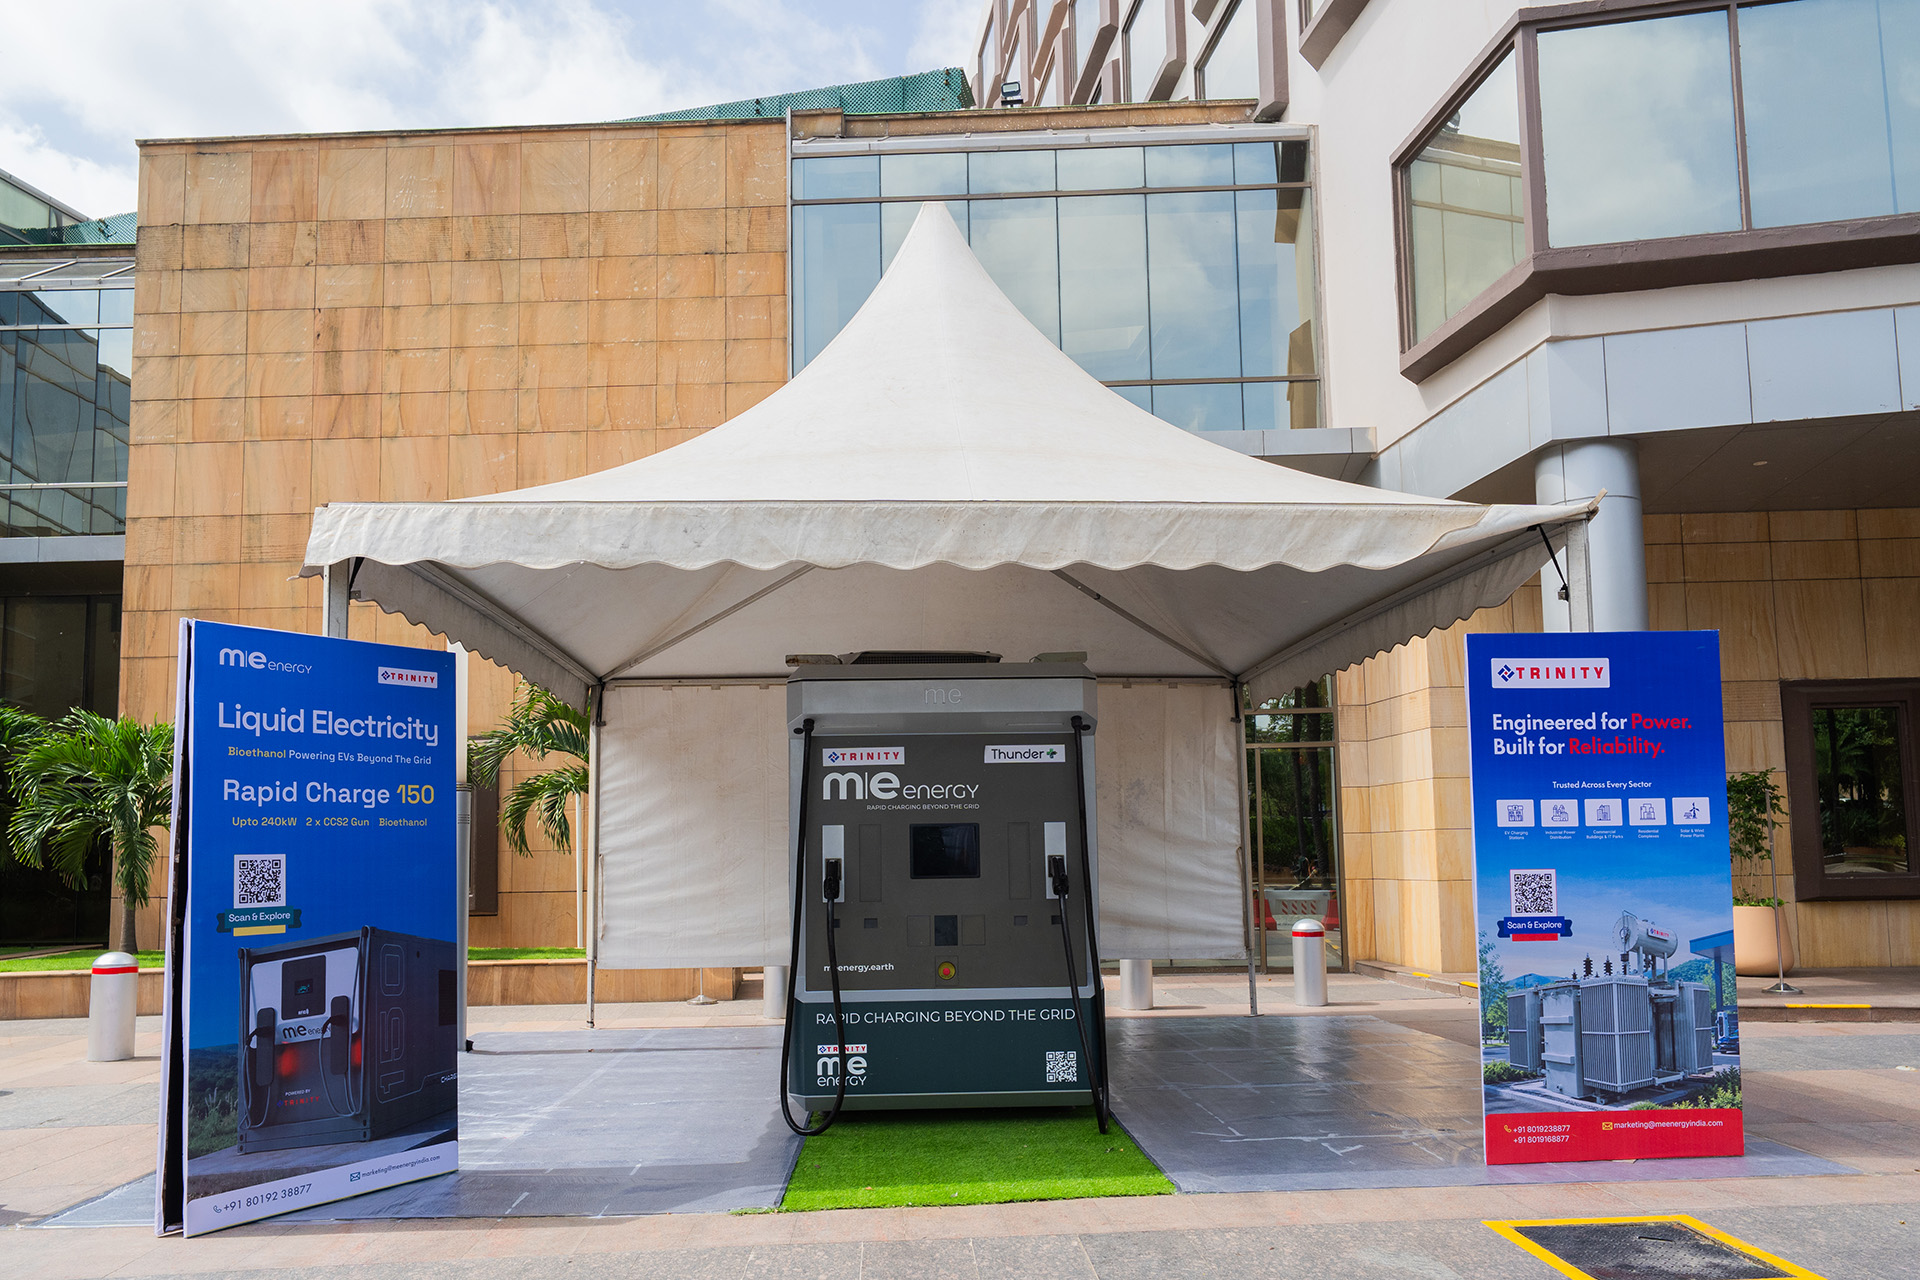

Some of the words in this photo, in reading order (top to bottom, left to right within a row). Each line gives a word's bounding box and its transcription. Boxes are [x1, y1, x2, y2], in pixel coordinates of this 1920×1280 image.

[390, 672, 436, 684] TRINITY
[1516, 666, 1604, 679] TRINITY
[924, 687, 962, 704] me
[218, 702, 304, 737] Liquid
[312, 710, 439, 746] Electricity
[1492, 712, 1597, 735] Engineered
[1600, 712, 1628, 730] for
[1631, 713, 1692, 730] Power.
[1494, 738, 1535, 755] Built
[1538, 737, 1566, 755] for
[1569, 736, 1665, 758] Reliability.
[228, 747, 286, 759] Bioethanol
[288, 750, 336, 763] Powering
[337, 752, 355, 762] EVs
[357, 753, 393, 765] Beyond
[395, 755, 411, 765] The
[413, 755, 432, 765] Grid
[840, 751, 900, 762] TRINITY
[1552, 780, 1580, 790] Trusted
[1581, 781, 1605, 789] Across
[1606, 780, 1628, 790] Every
[1628, 780, 1652, 789] Sector
[223, 779, 298, 807] Rapid
[305, 782, 390, 808] Charge
[396, 784, 435, 804] 150
[231, 816, 259, 829] Upto
[261, 816, 298, 827] 240kW
[305, 817, 312, 827] 2
[314, 819, 321, 827] x
[323, 817, 349, 827] CCS2
[351, 818, 370, 827] Gun
[378, 817, 428, 827] Bioethanol
[228, 914, 251, 922] Scan
[252, 913, 258, 921] &
[259, 911, 291, 922] Explore
[1507, 921, 1526, 929] Scan
[1527, 921, 1533, 929] &
[1534, 920, 1563, 931] Explore
[823, 963, 894, 973] menergy.earth
[863, 1011, 940, 1023] CHARGING
[944, 1010, 1005, 1022] BEYOND
[1008, 1009, 1036, 1021] THE
[1039, 1008, 1076, 1020] GRID
[284, 1096, 320, 1106] TRINITY
[1527, 1125, 1570, 1133] 8019238877
[1614, 1120, 1723, 1130] marketing@meenergyindia.com
[1527, 1135, 1569, 1143] 8019168877
[361, 1155, 440, 1178] marketing@meenergyindia.com
[223, 1199, 242, 1211] +91
[246, 1192, 278, 1207] 80192
[281, 1183, 312, 1199] 38877
